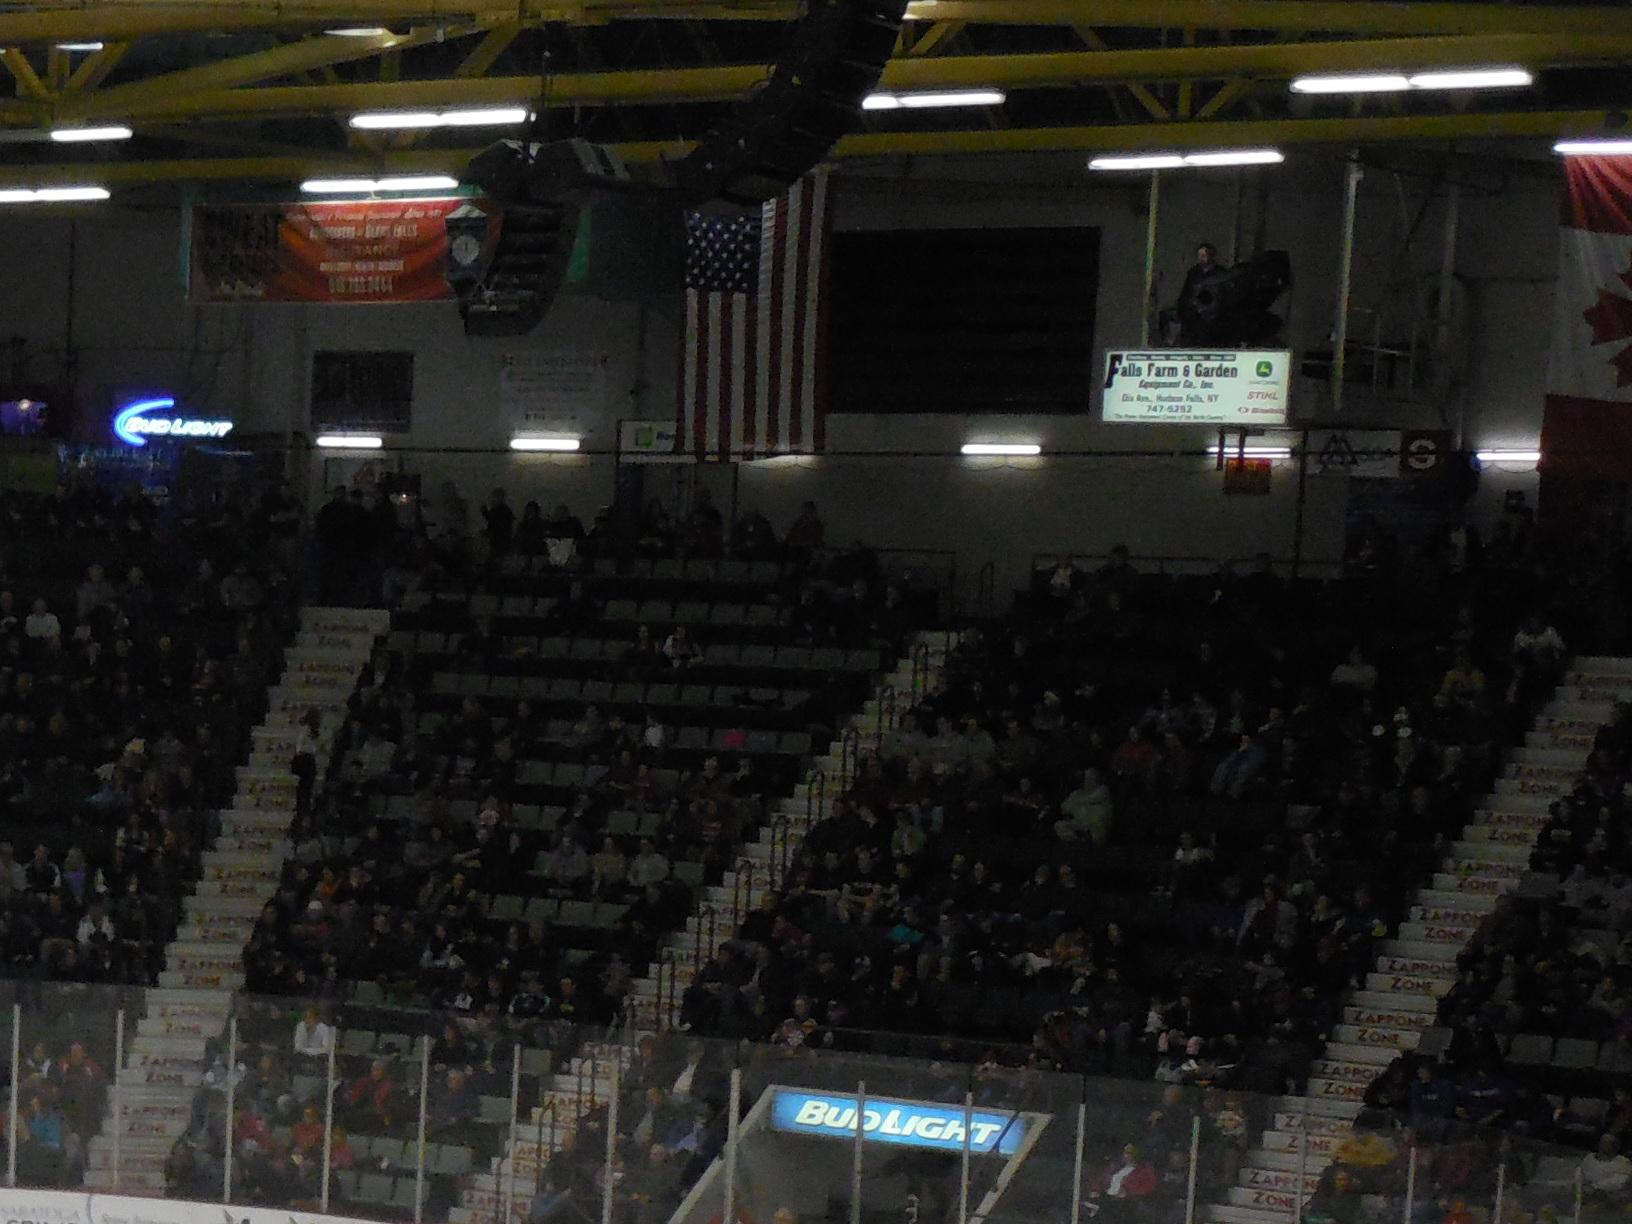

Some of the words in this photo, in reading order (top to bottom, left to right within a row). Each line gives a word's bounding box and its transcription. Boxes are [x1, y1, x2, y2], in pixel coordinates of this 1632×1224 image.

[1104, 354, 1142, 388] Falls
[1147, 364, 1178, 377] Farm
[1195, 364, 1238, 377] Garden
[1248, 391, 1279, 400] STIHL
[127, 417, 170, 434] BUD
[170, 419, 233, 437] LIGHT
[1353, 1009, 1427, 1026] ZAPPONE
[1357, 1028, 1400, 1043] ZONE
[795, 1100, 880, 1132] BUD
[879, 1110, 1002, 1145] LIGHT
[1287, 1134, 1330, 1152] ZNE
